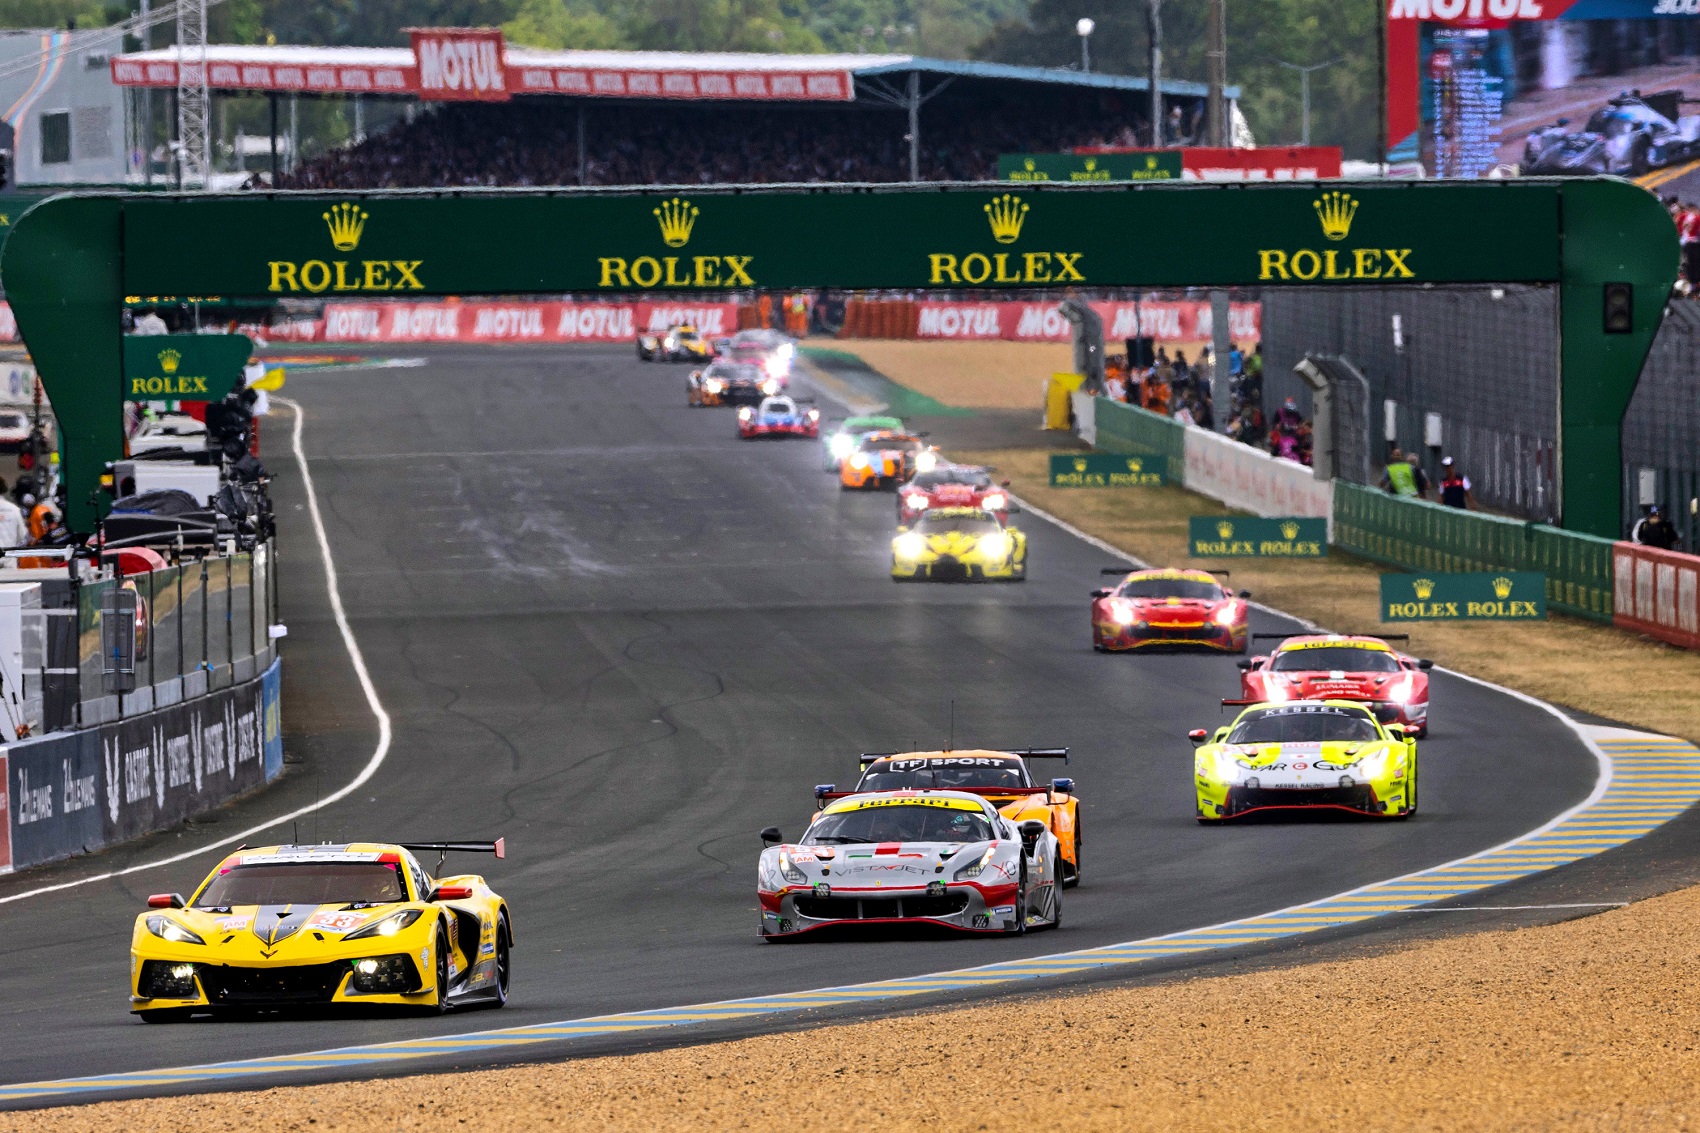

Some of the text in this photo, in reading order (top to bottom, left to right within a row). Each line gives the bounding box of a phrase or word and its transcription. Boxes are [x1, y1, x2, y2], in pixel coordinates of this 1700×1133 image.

[420, 39, 505, 91] MOTUL
[267, 248, 1416, 293] ROLEX ROLEX ROLEX ROLEX
[325, 309, 380, 337] MOTUL
[390, 308, 459, 337] MOTUL
[472, 308, 544, 337] MOTUL
[557, 307, 636, 337] MOTUL
[918, 306, 999, 336] MOTUL
[131, 376, 209, 395] ROLEX
[1196, 540, 1320, 555] ROLEX ROLEX
[1389, 601, 1539, 618] ROLEX ROLEX
[1265, 706, 1344, 716] KESSEL
[898, 758, 1005, 769] TF SPORT
[319, 913, 356, 928] 33
